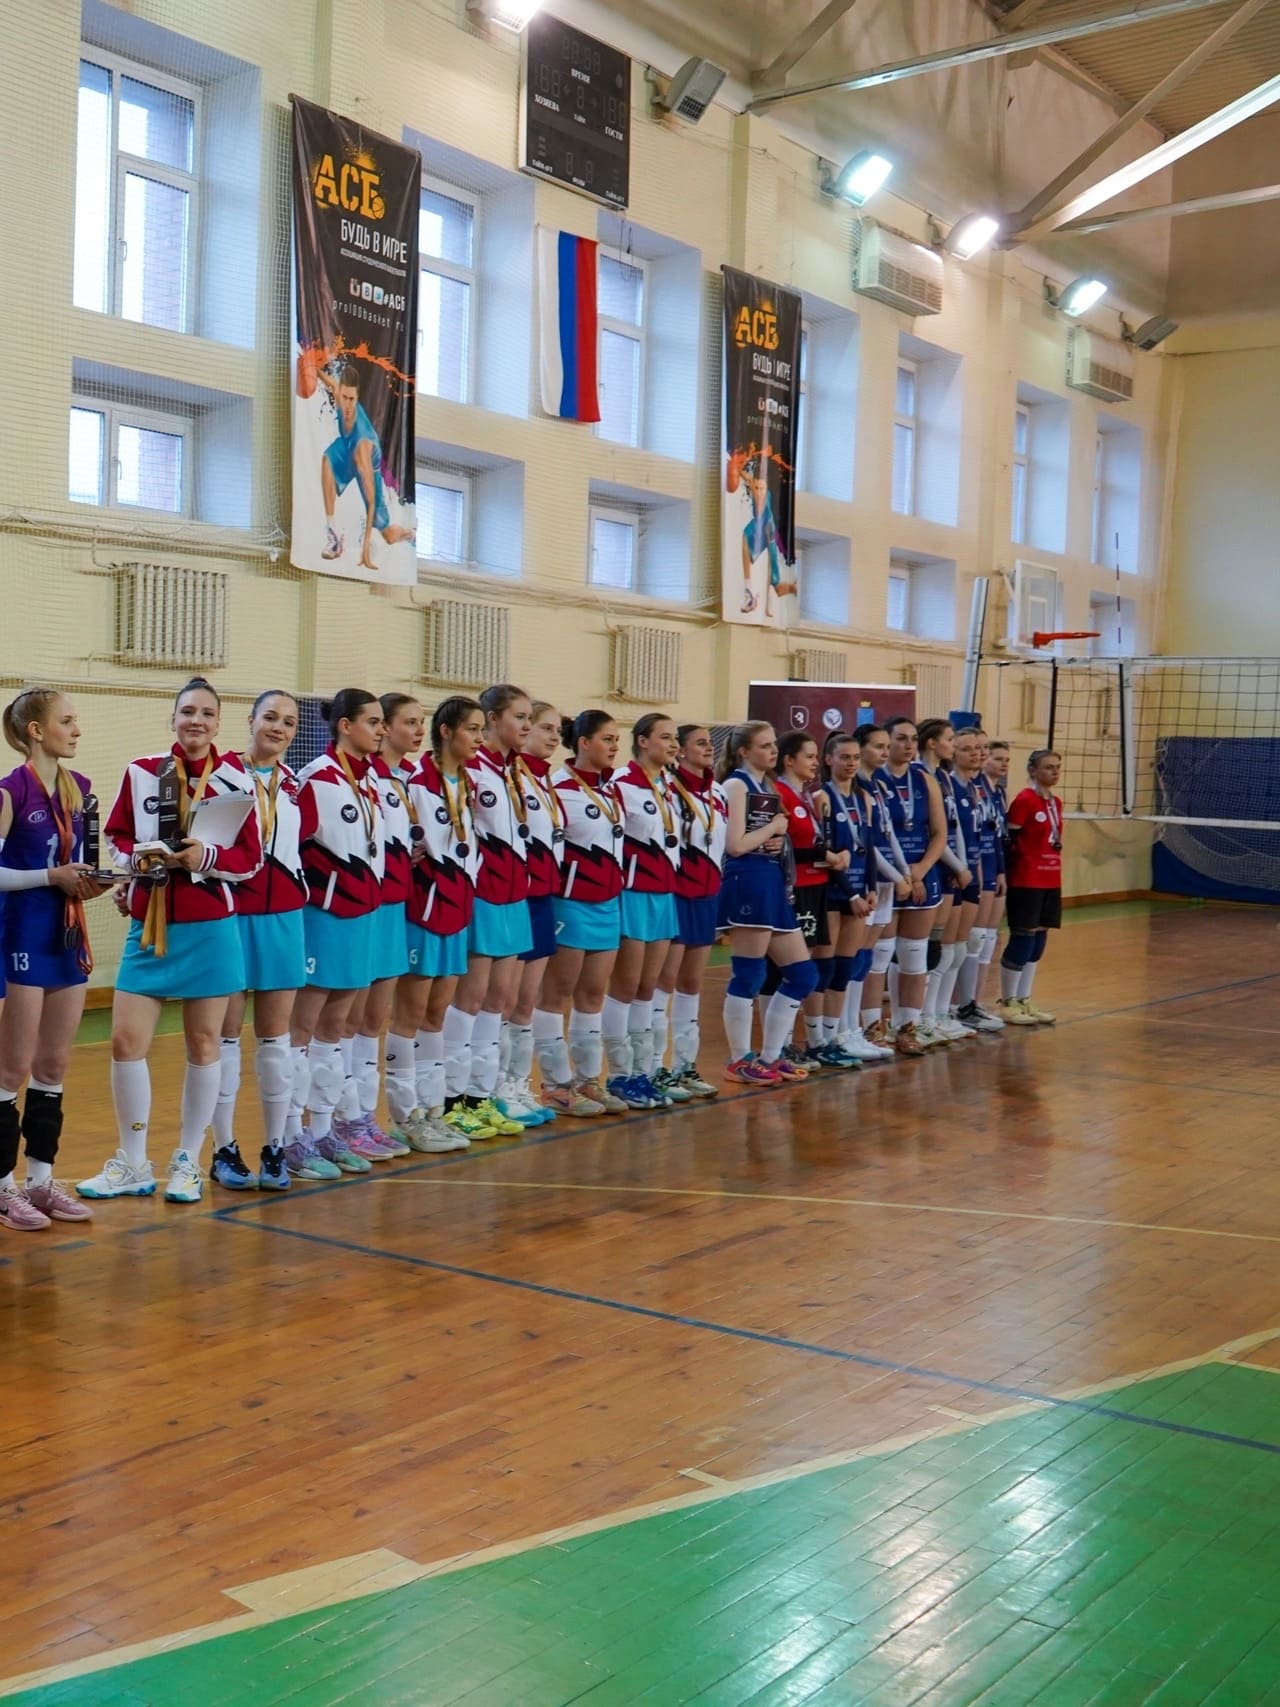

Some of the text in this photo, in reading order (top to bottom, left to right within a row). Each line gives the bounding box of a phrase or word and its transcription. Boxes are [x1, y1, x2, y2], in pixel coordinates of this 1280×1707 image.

[314, 153, 385, 220] АСБ
[341, 219, 370, 250] БУДЬ
[373, 231, 380, 253] В
[382, 235, 407, 263] ИГРЕ
[735, 306, 779, 350] АСБ
[11, 952, 30, 971] 13
[305, 957, 317, 975] 3
[410, 949, 419, 965] 6
